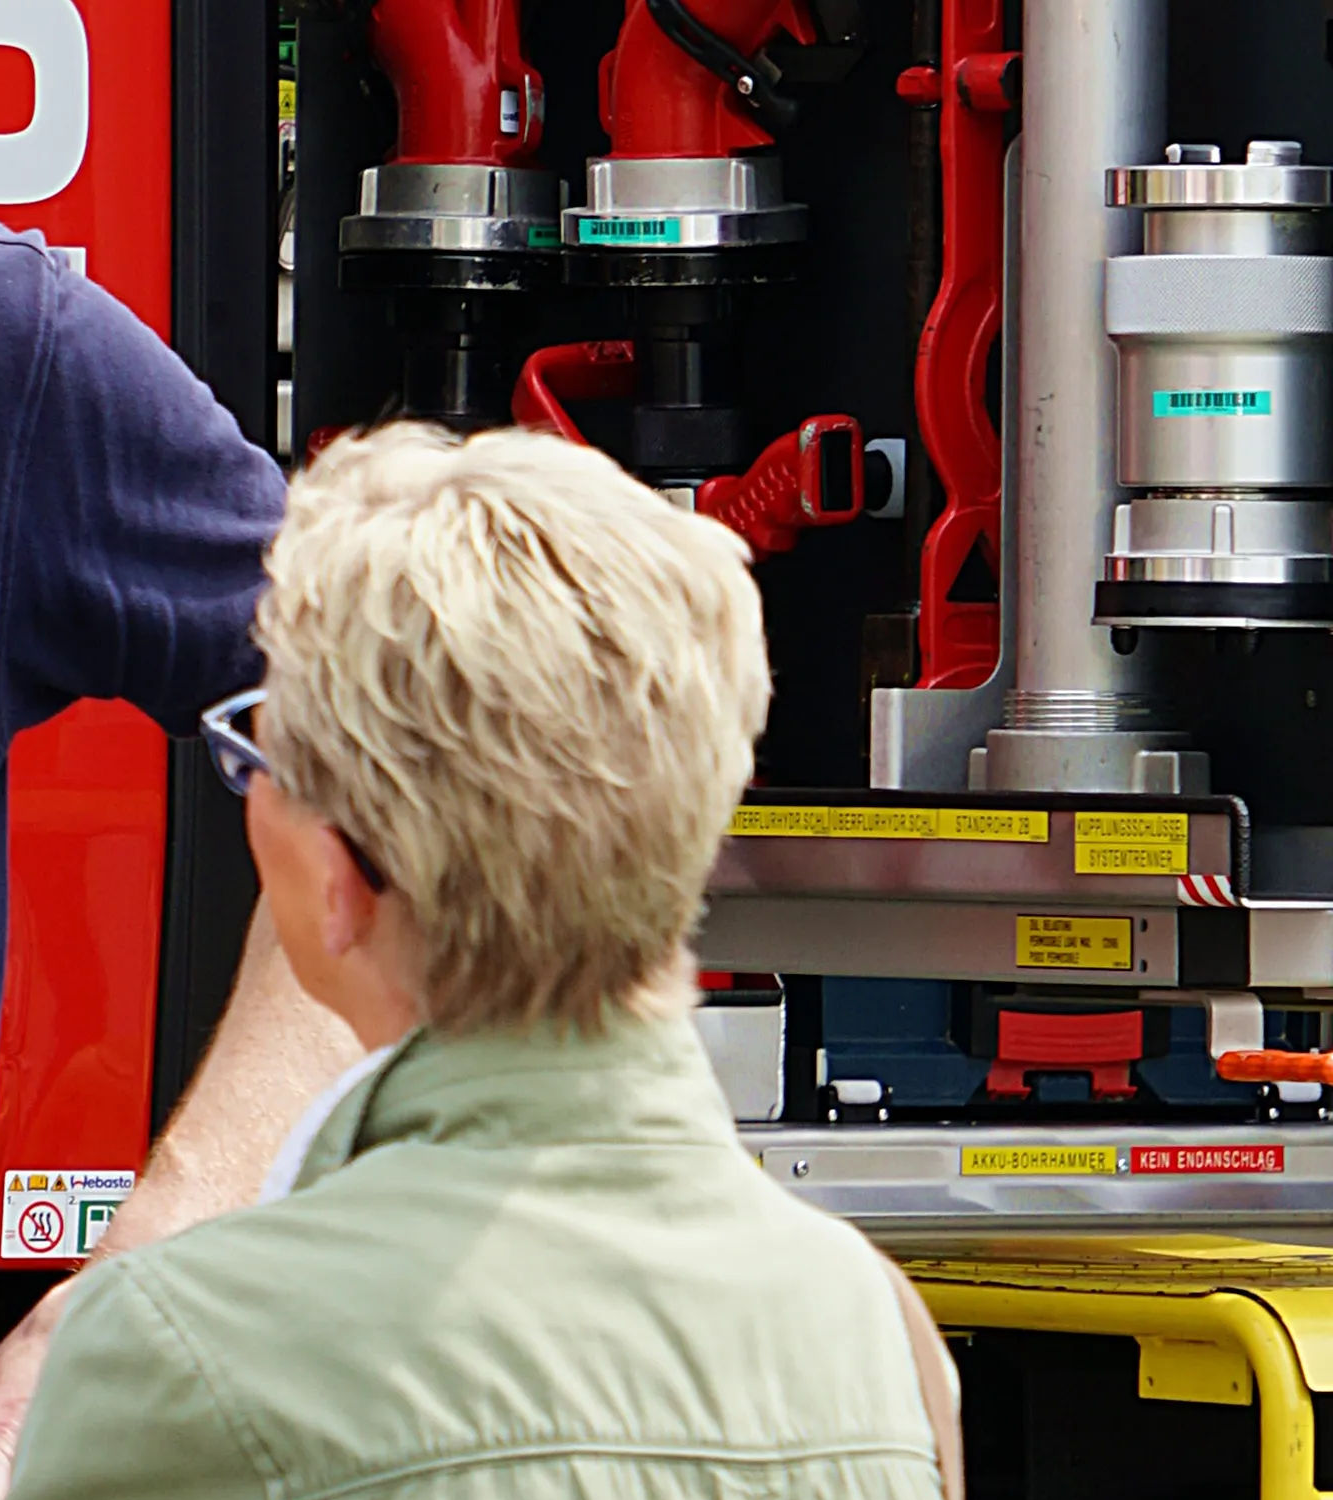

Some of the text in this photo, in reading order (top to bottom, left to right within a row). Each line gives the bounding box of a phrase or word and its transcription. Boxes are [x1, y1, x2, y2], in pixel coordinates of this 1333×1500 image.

[955, 815, 1013, 835] STANDROHR
[971, 1152, 1106, 1170] AKKU-BOHRHAMMER
[1139, 1150, 1277, 1169] KEIN ENDANSCHLAG
[70, 1175, 132, 1189] Webasto
